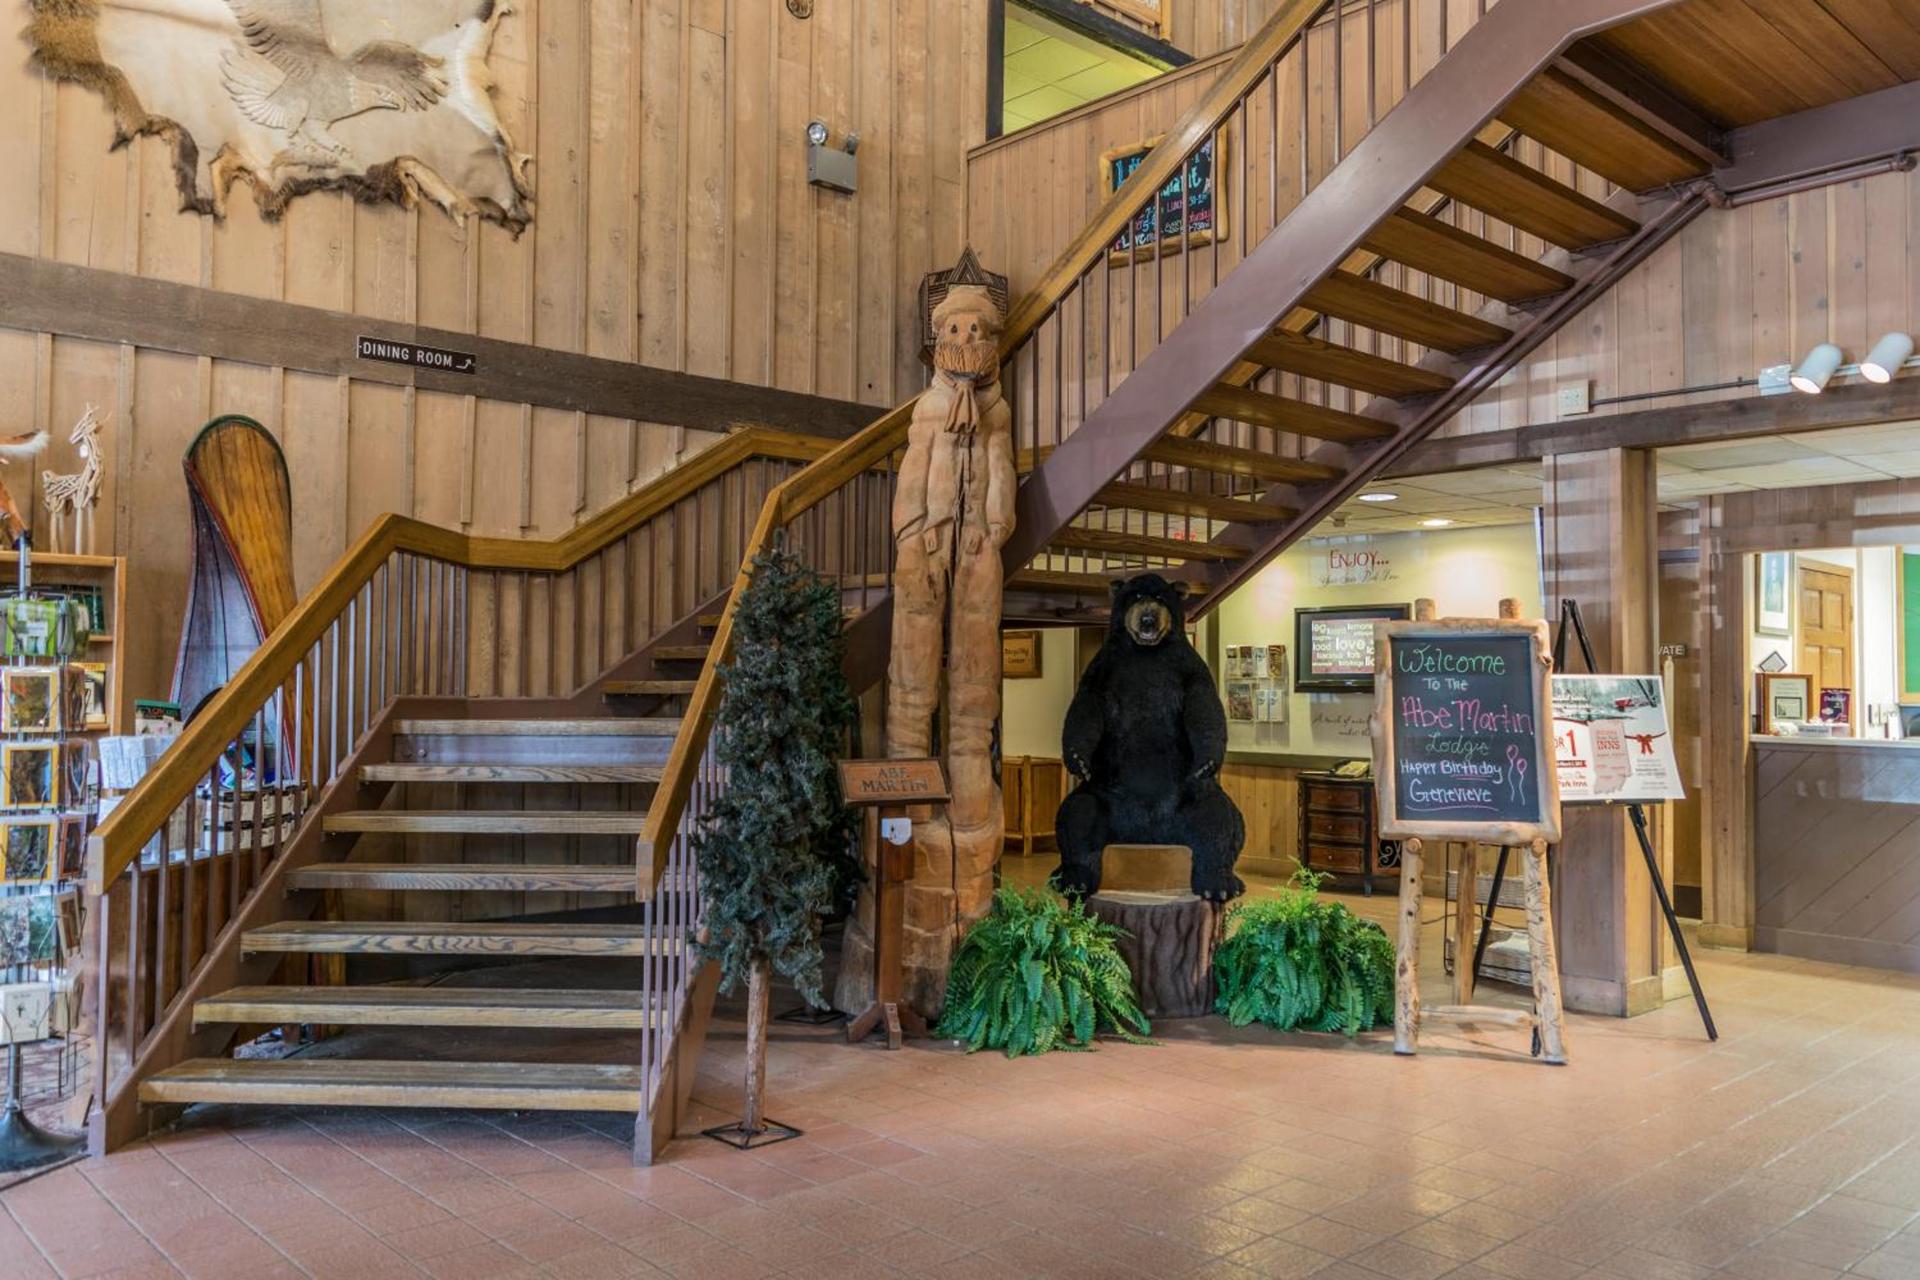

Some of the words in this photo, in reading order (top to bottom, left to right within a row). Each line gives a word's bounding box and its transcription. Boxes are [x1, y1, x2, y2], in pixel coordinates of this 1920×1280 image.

[363, 341, 409, 360] DINING
[416, 350, 453, 367] ROOM
[1335, 637, 1366, 651] love
[1399, 644, 1506, 675] Welcome
[1424, 678, 1441, 690] To
[1445, 677, 1469, 691] The
[1401, 696, 1454, 729] Abe
[1451, 698, 1535, 735] Martin
[1426, 732, 1489, 760] Lodge
[878, 767, 910, 778] ABE
[861, 780, 929, 792] MARTIN
